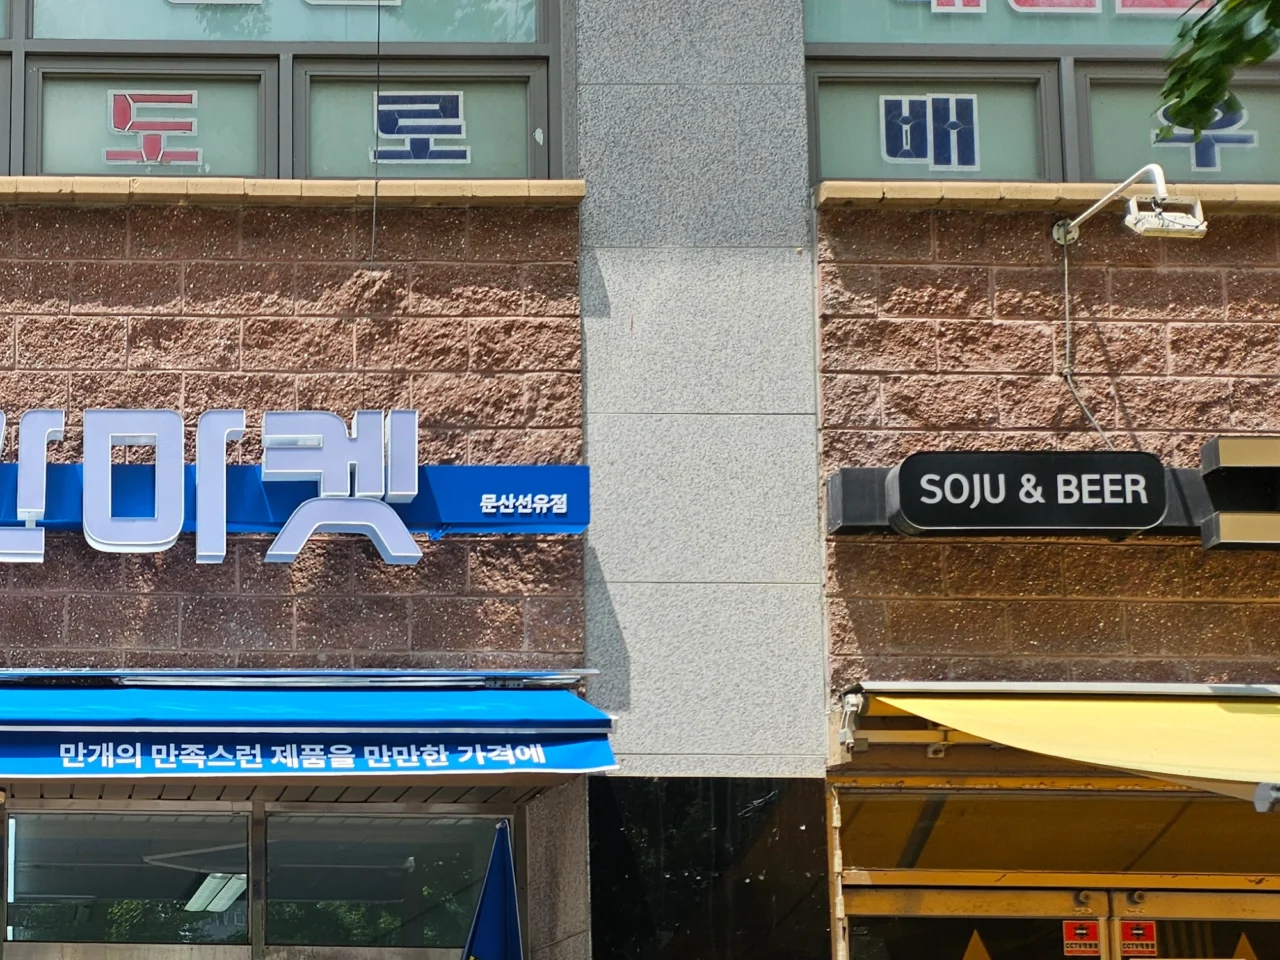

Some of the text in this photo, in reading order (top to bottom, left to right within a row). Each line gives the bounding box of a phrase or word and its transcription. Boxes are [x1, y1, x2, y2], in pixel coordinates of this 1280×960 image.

[480, 493, 569, 515] 문산선유점
[920, 473, 1149, 509] SOJU & BEER
[60, 742, 546, 769] 만개의 만족스런 제품을 만만한 가격에
